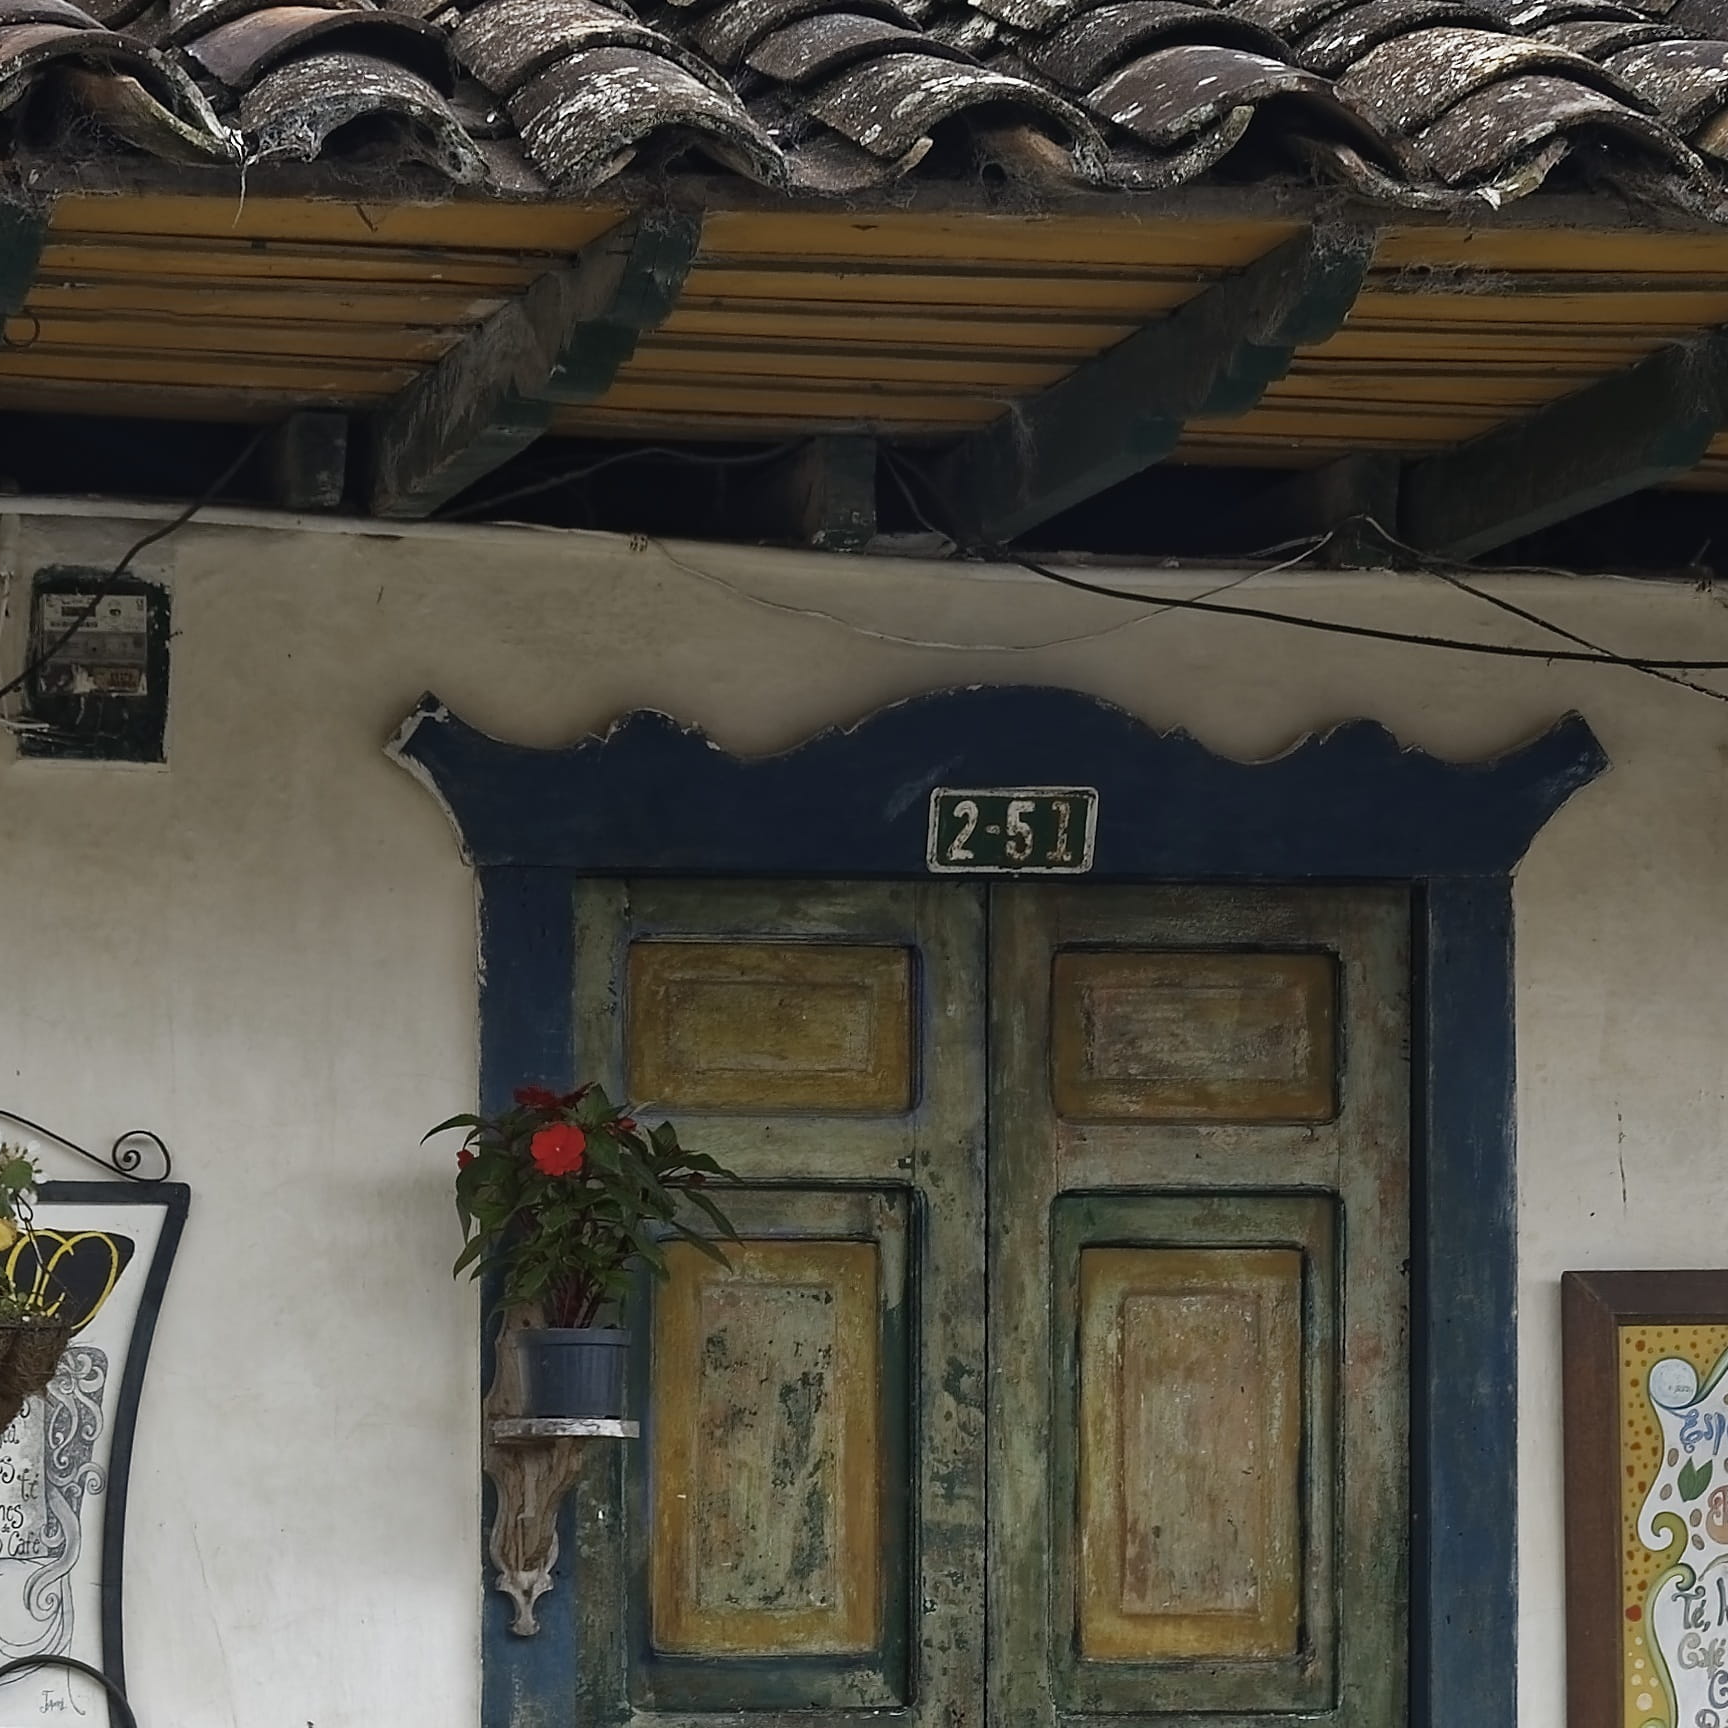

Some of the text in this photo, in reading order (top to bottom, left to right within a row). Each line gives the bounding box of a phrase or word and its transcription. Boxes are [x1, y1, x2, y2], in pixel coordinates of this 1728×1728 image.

[946, 799, 1072, 861] 2-51
[1671, 1585, 1711, 1633] Té,
[1677, 1632, 1727, 1680] Café
